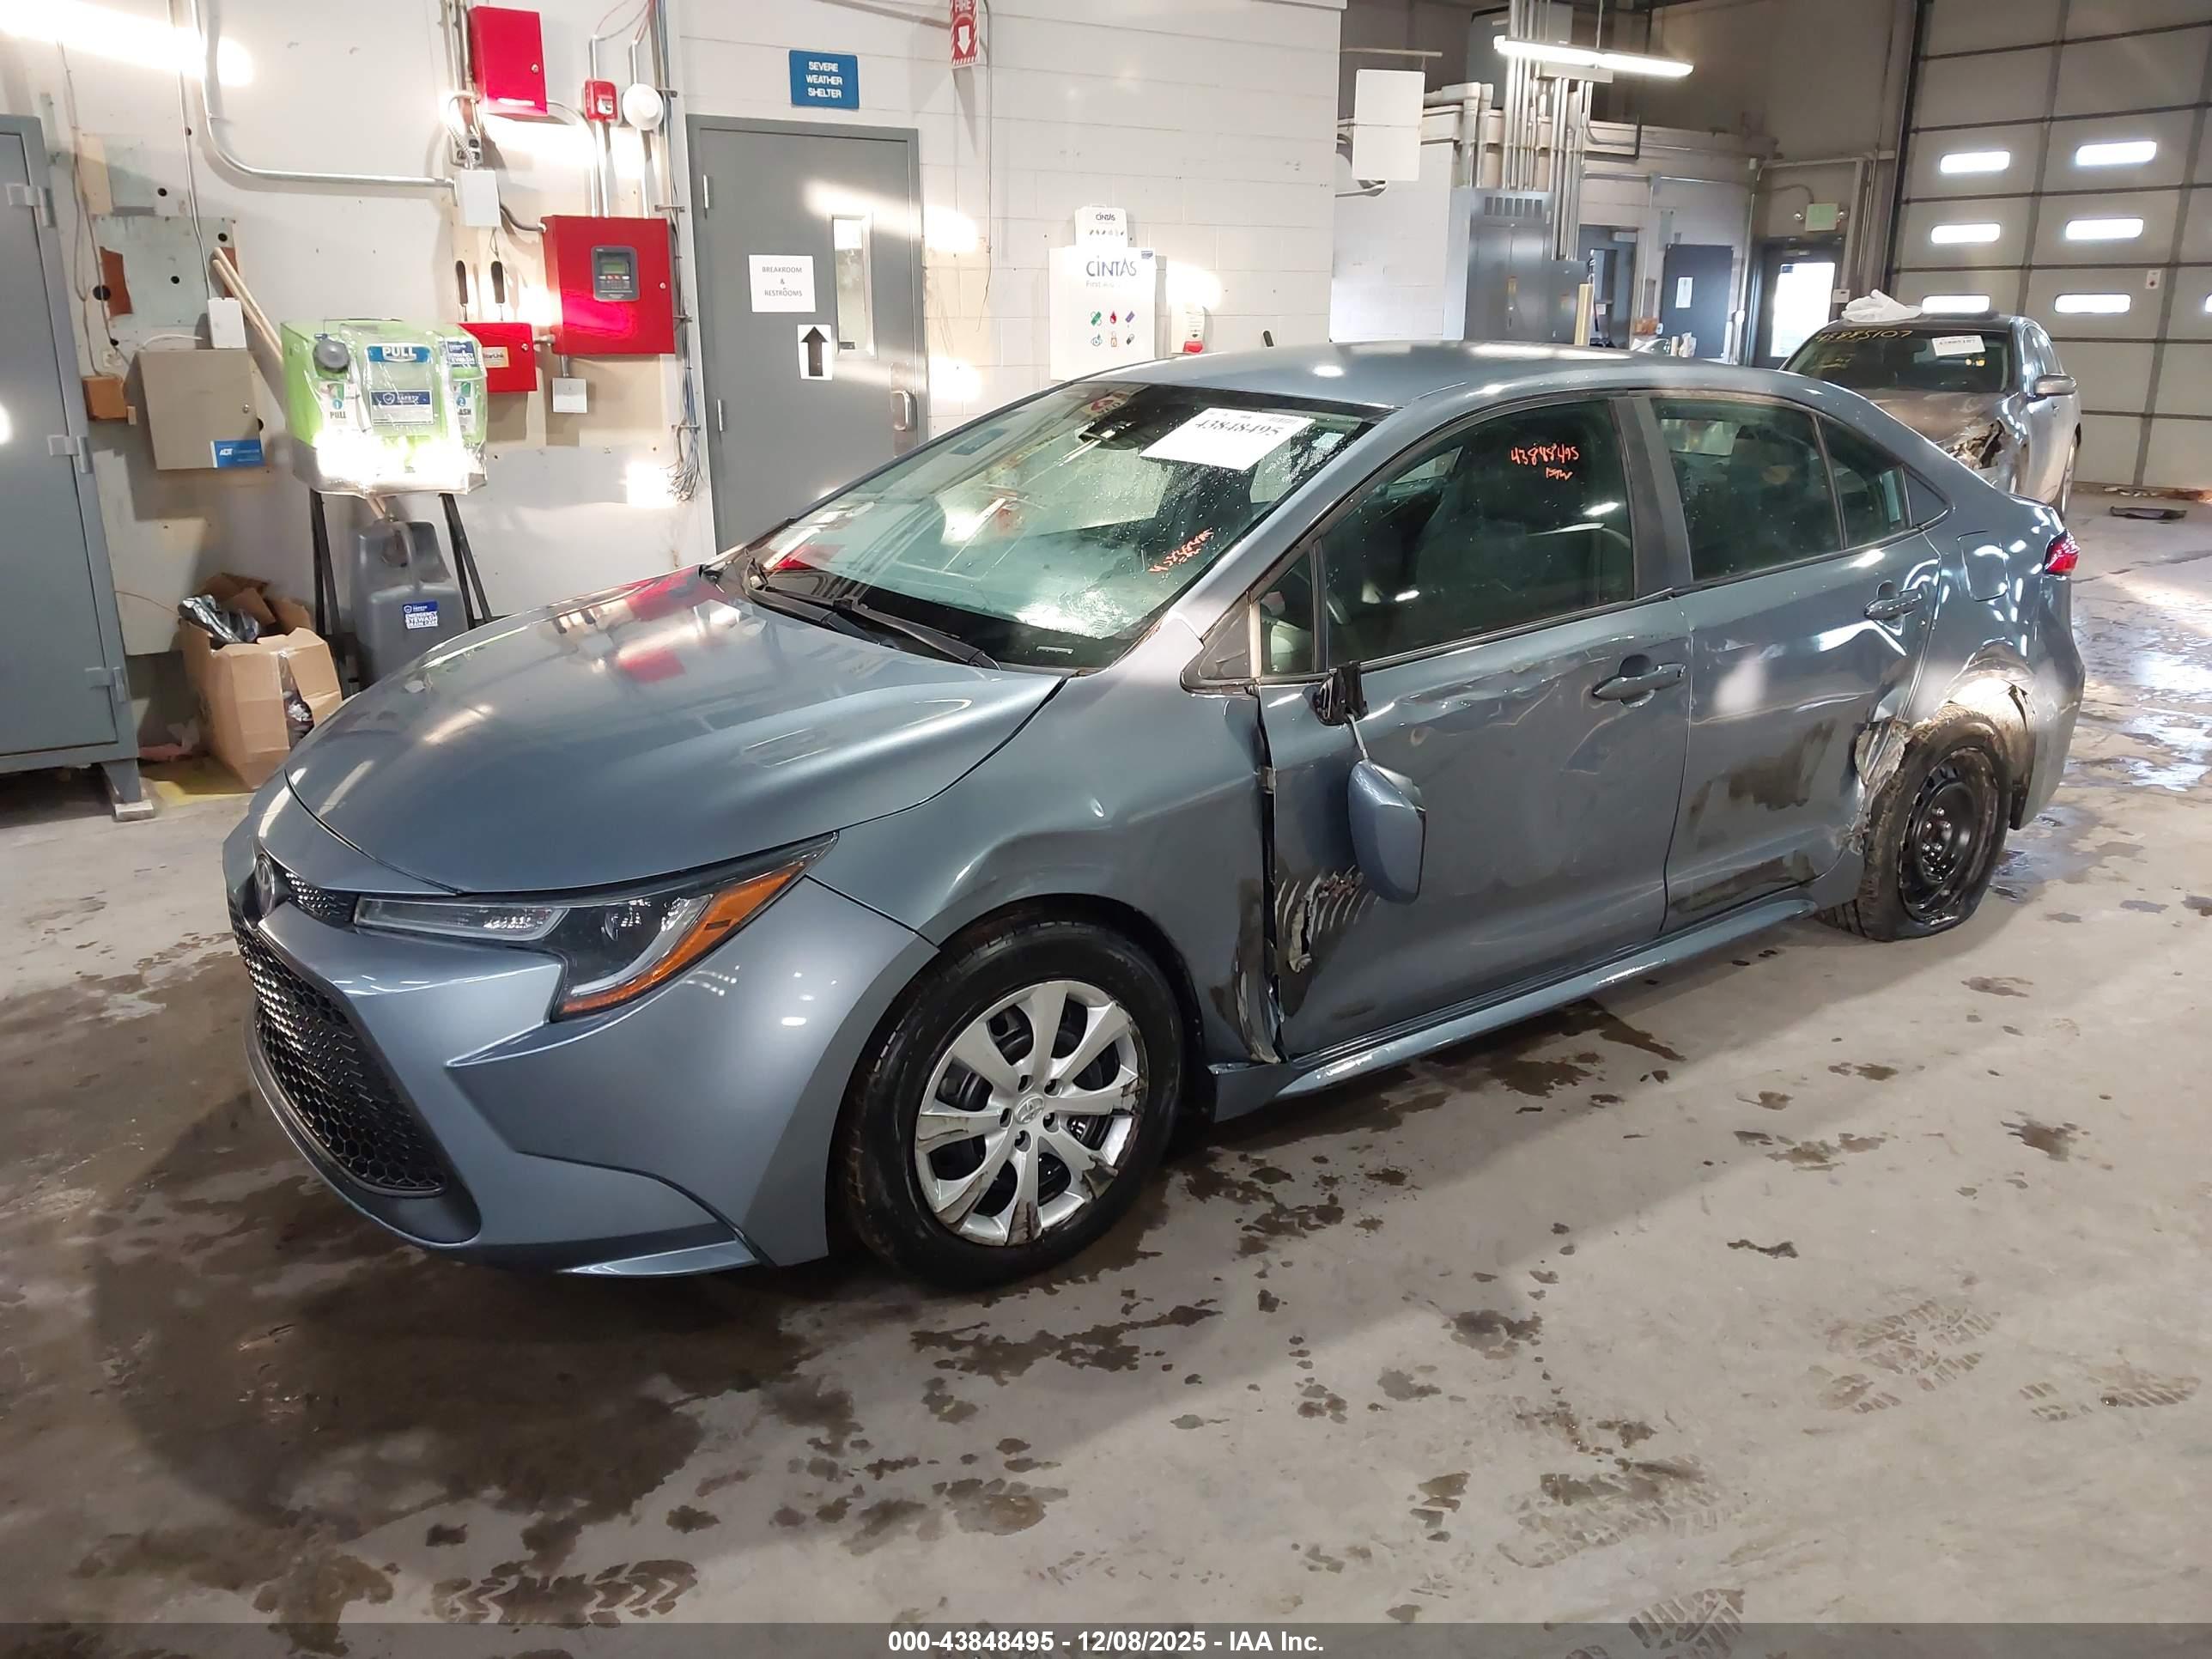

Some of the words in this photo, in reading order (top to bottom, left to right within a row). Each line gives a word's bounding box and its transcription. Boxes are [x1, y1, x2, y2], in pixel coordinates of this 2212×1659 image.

[954, 0, 973, 12] FIRE
[808, 61, 839, 72] SEVERE
[805, 74, 843, 85] WEATHER
[807, 87, 842, 99] SHELTER
[381, 346, 415, 358] PULL
[330, 411, 346, 420] PULL
